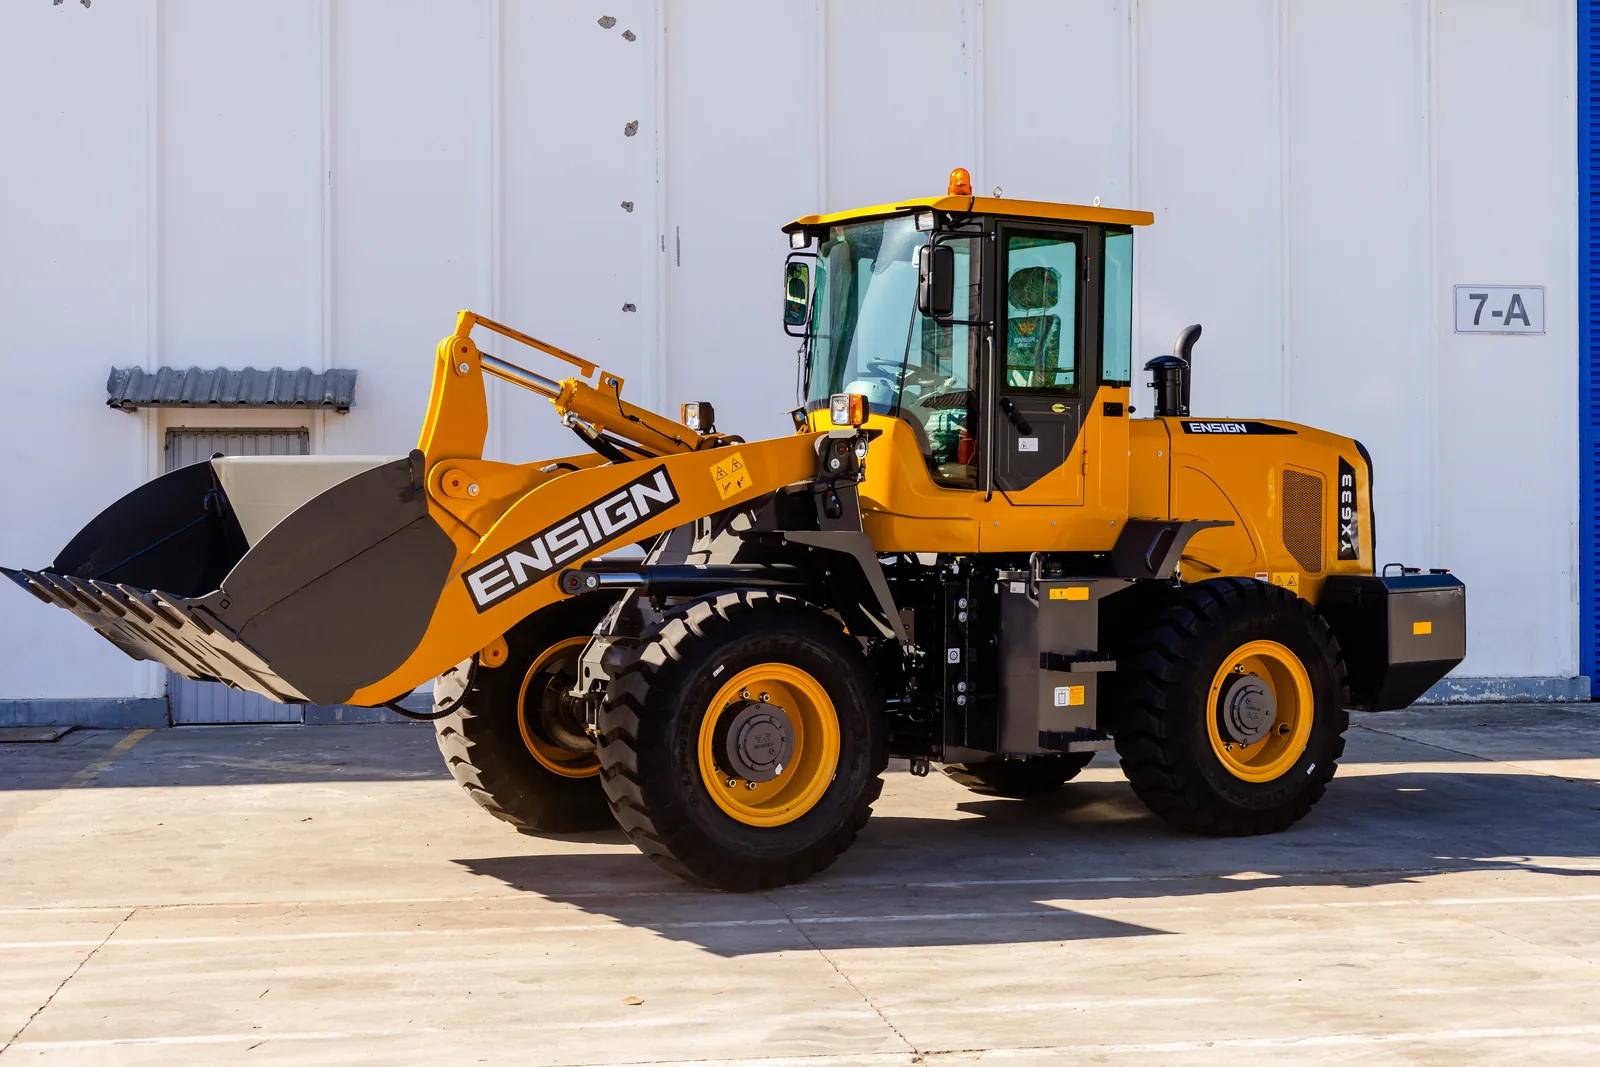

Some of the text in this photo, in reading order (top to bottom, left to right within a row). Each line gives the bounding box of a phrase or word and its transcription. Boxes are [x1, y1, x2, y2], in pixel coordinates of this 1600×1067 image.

[1469, 293, 1531, 326] 7-A
[1189, 422, 1248, 433] ENSIGN
[467, 470, 674, 606] ENSIGN
[1341, 474, 1352, 552] YX633
